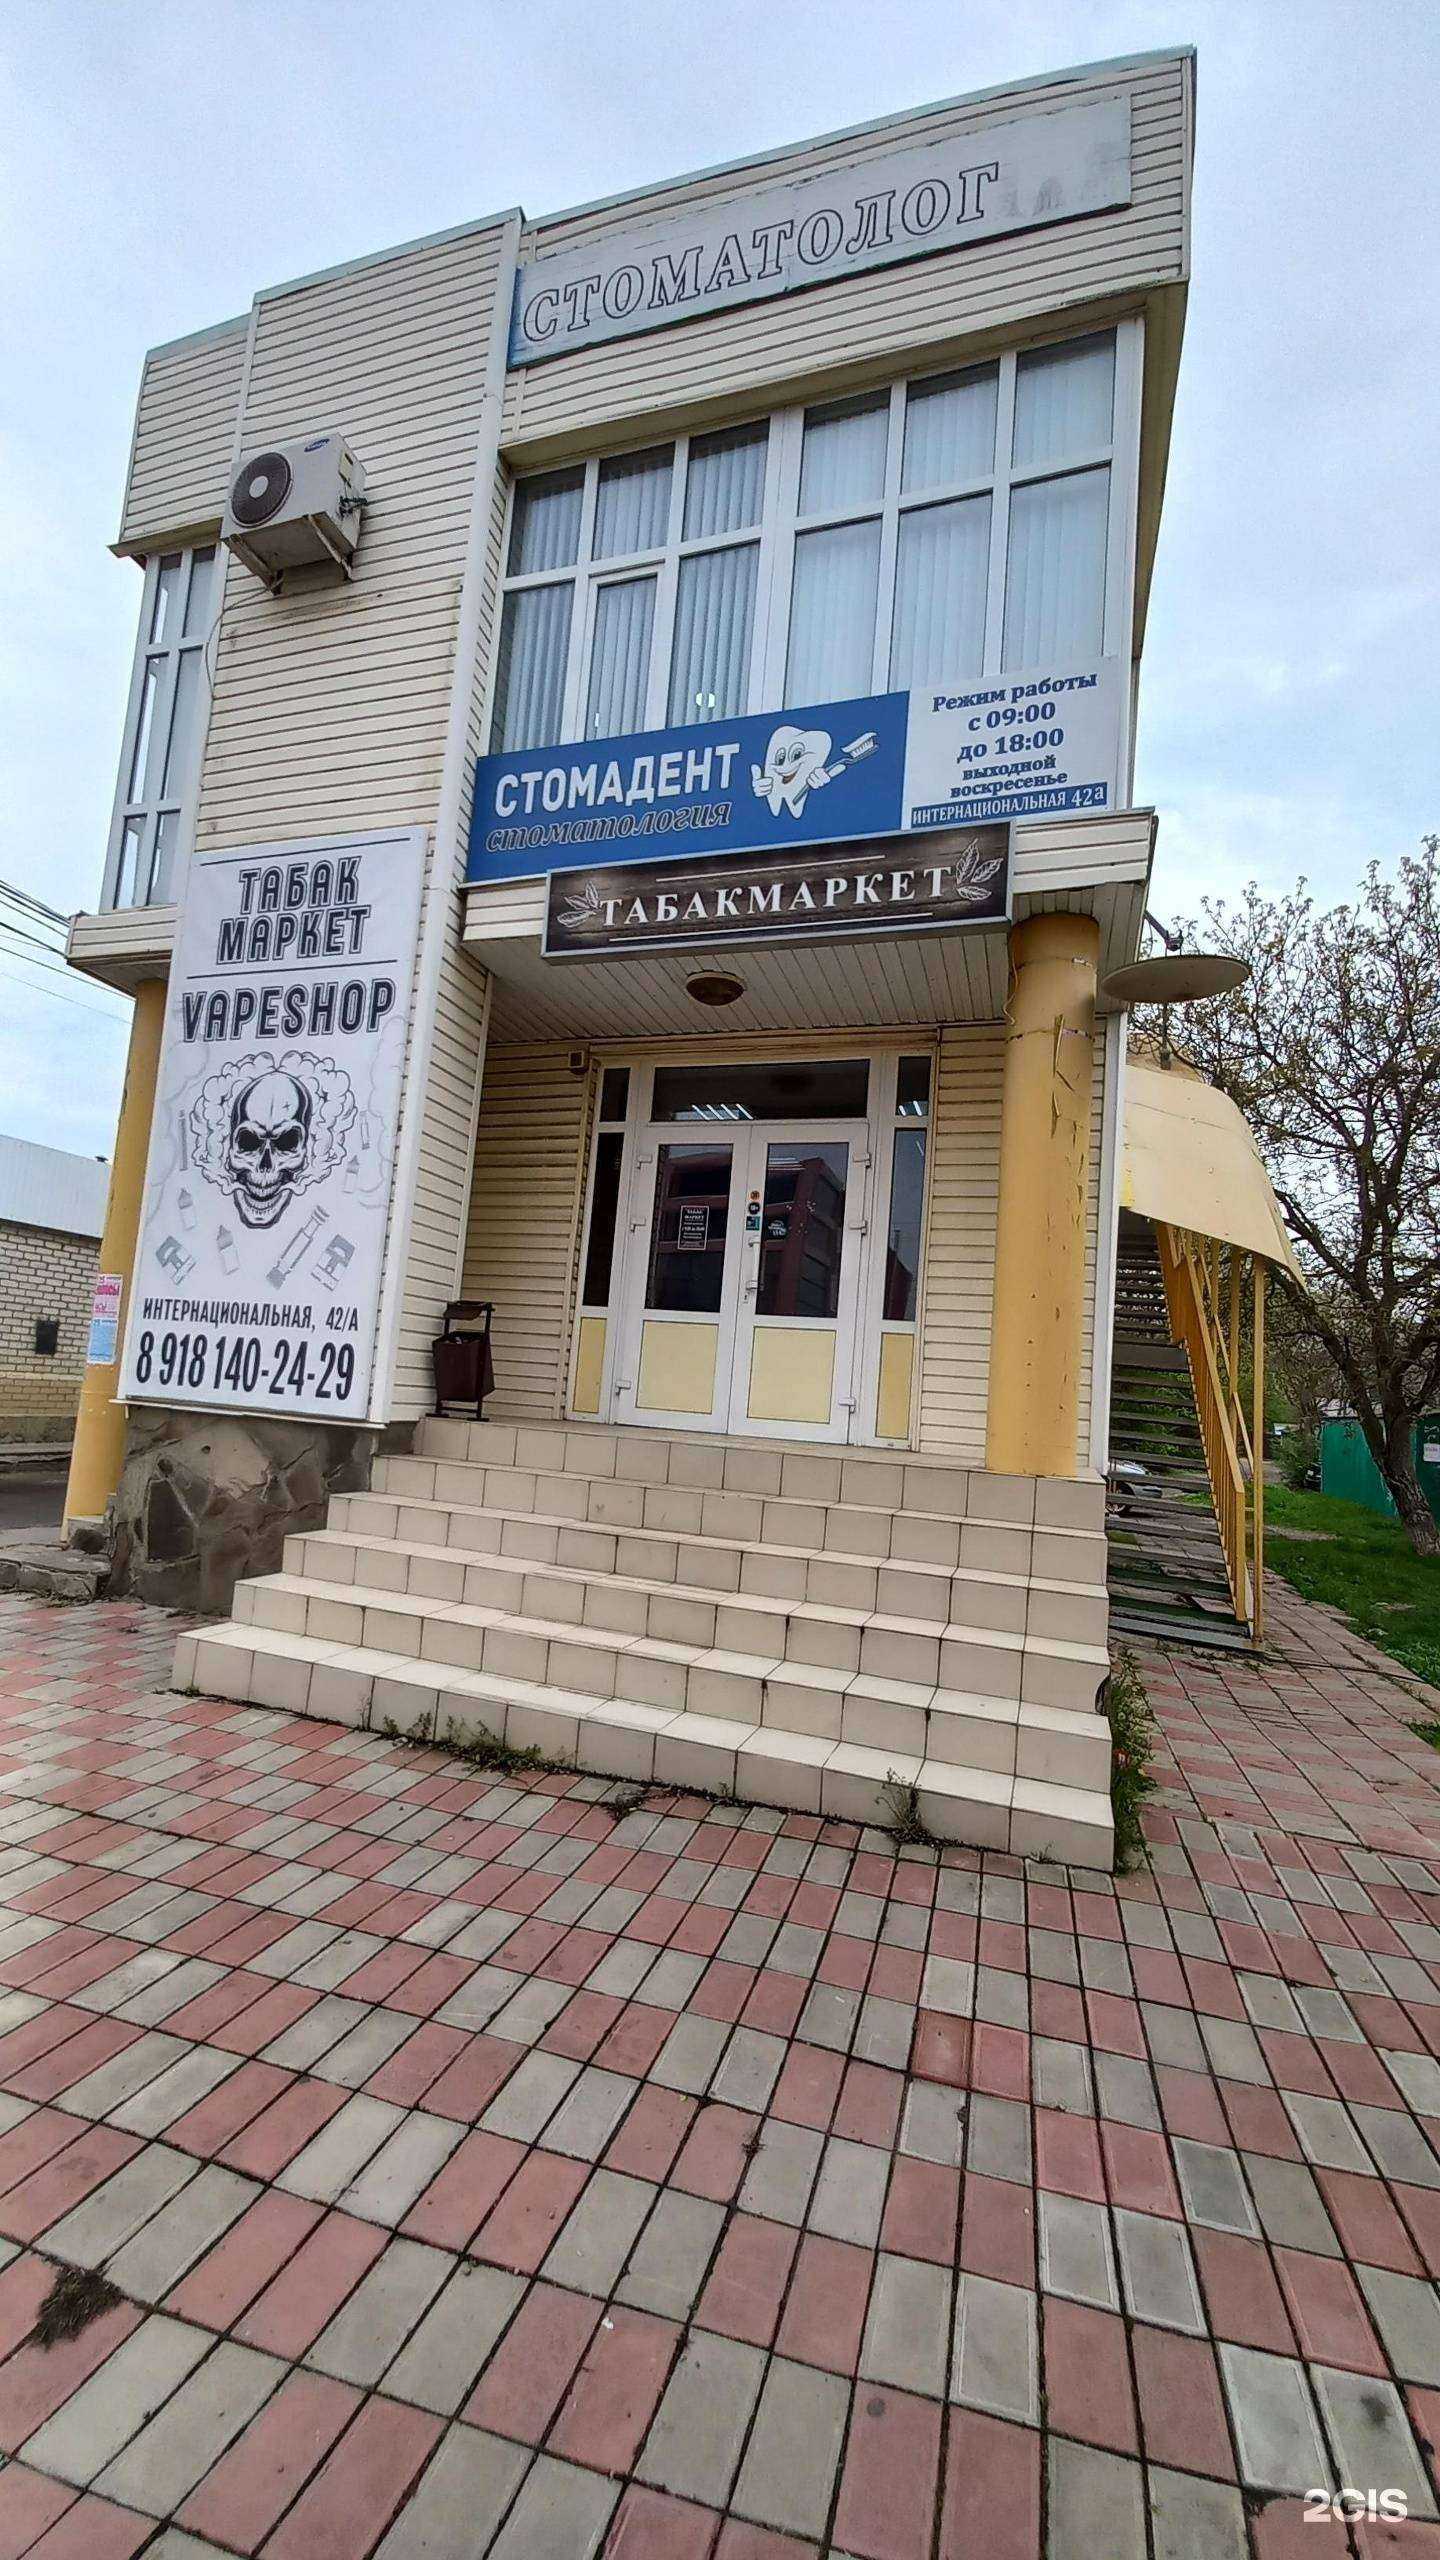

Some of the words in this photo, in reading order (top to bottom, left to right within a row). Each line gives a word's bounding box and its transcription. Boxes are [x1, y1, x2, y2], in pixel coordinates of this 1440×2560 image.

[523, 161, 999, 342] СТОМАТОЛОГ
[932, 687, 1006, 712] Режим
[1011, 673, 1098, 703] работы
[968, 716, 981, 731] с
[986, 702, 1056, 728] 09:00
[957, 743, 988, 764] до
[994, 728, 1064, 755] 18:00
[962, 754, 1057, 781] выходной
[494, 742, 741, 818] СТОМАДЕНТ
[950, 772, 1068, 798] воскресенье
[486, 801, 732, 852] стоматология
[912, 792, 1067, 825] ИНТЕРНАЦИОНАЛЬНАЯ
[238, 856, 362, 915] ТАБАК
[600, 866, 952, 927] ТАБАКМАРКЕТ
[216, 904, 372, 965] МАРКЕТ
[182, 977, 396, 1043] VAPESHOP
[142, 1297, 316, 1333] ИНТЕРНАЦИОНАЛЬНАЯ,
[325, 1305, 359, 1332] 42/А
[136, 1330, 155, 1384] 8
[159, 1332, 208, 1388] 918
[213, 1335, 355, 1401] 140-24-29
